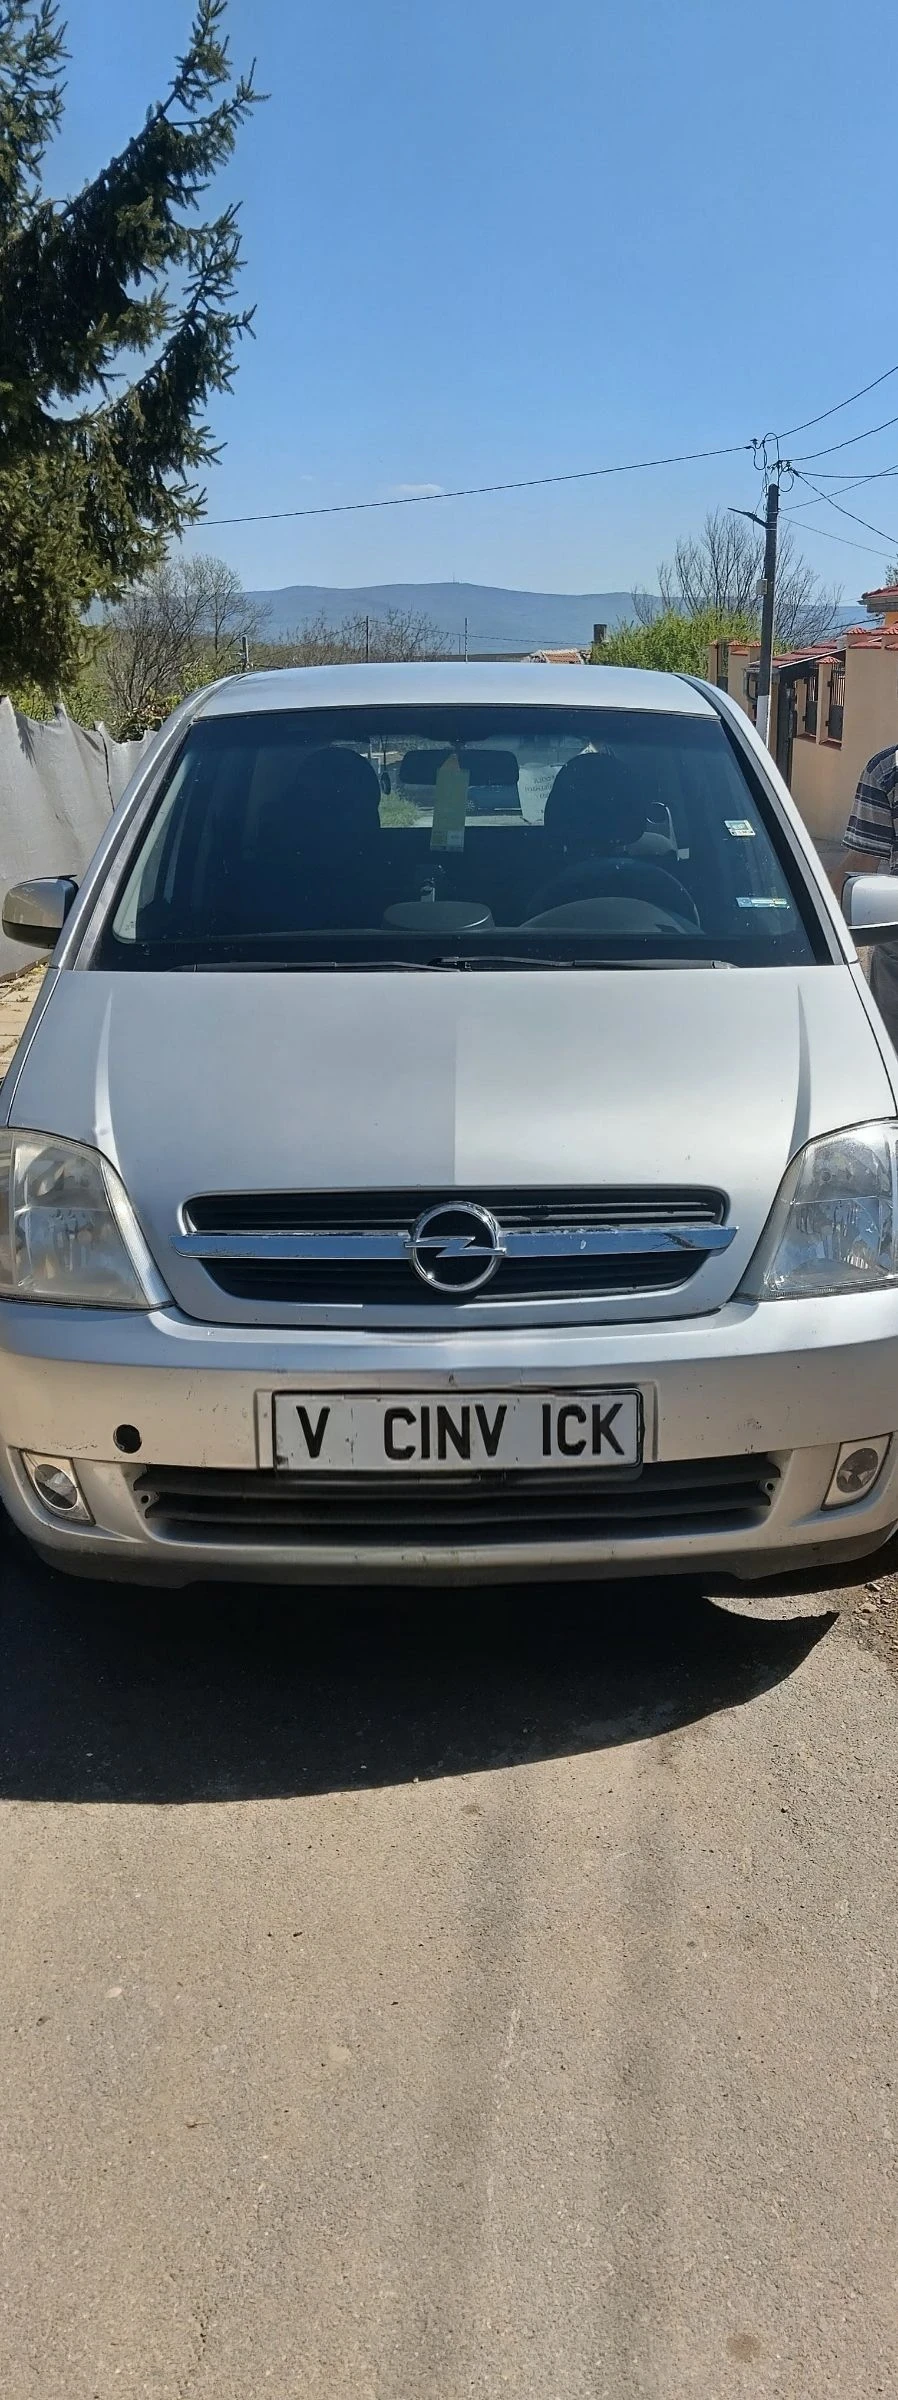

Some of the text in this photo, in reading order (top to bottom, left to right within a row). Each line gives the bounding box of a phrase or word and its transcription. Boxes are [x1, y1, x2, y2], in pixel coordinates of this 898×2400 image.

[296, 1403, 625, 1460] V CINV ICK
